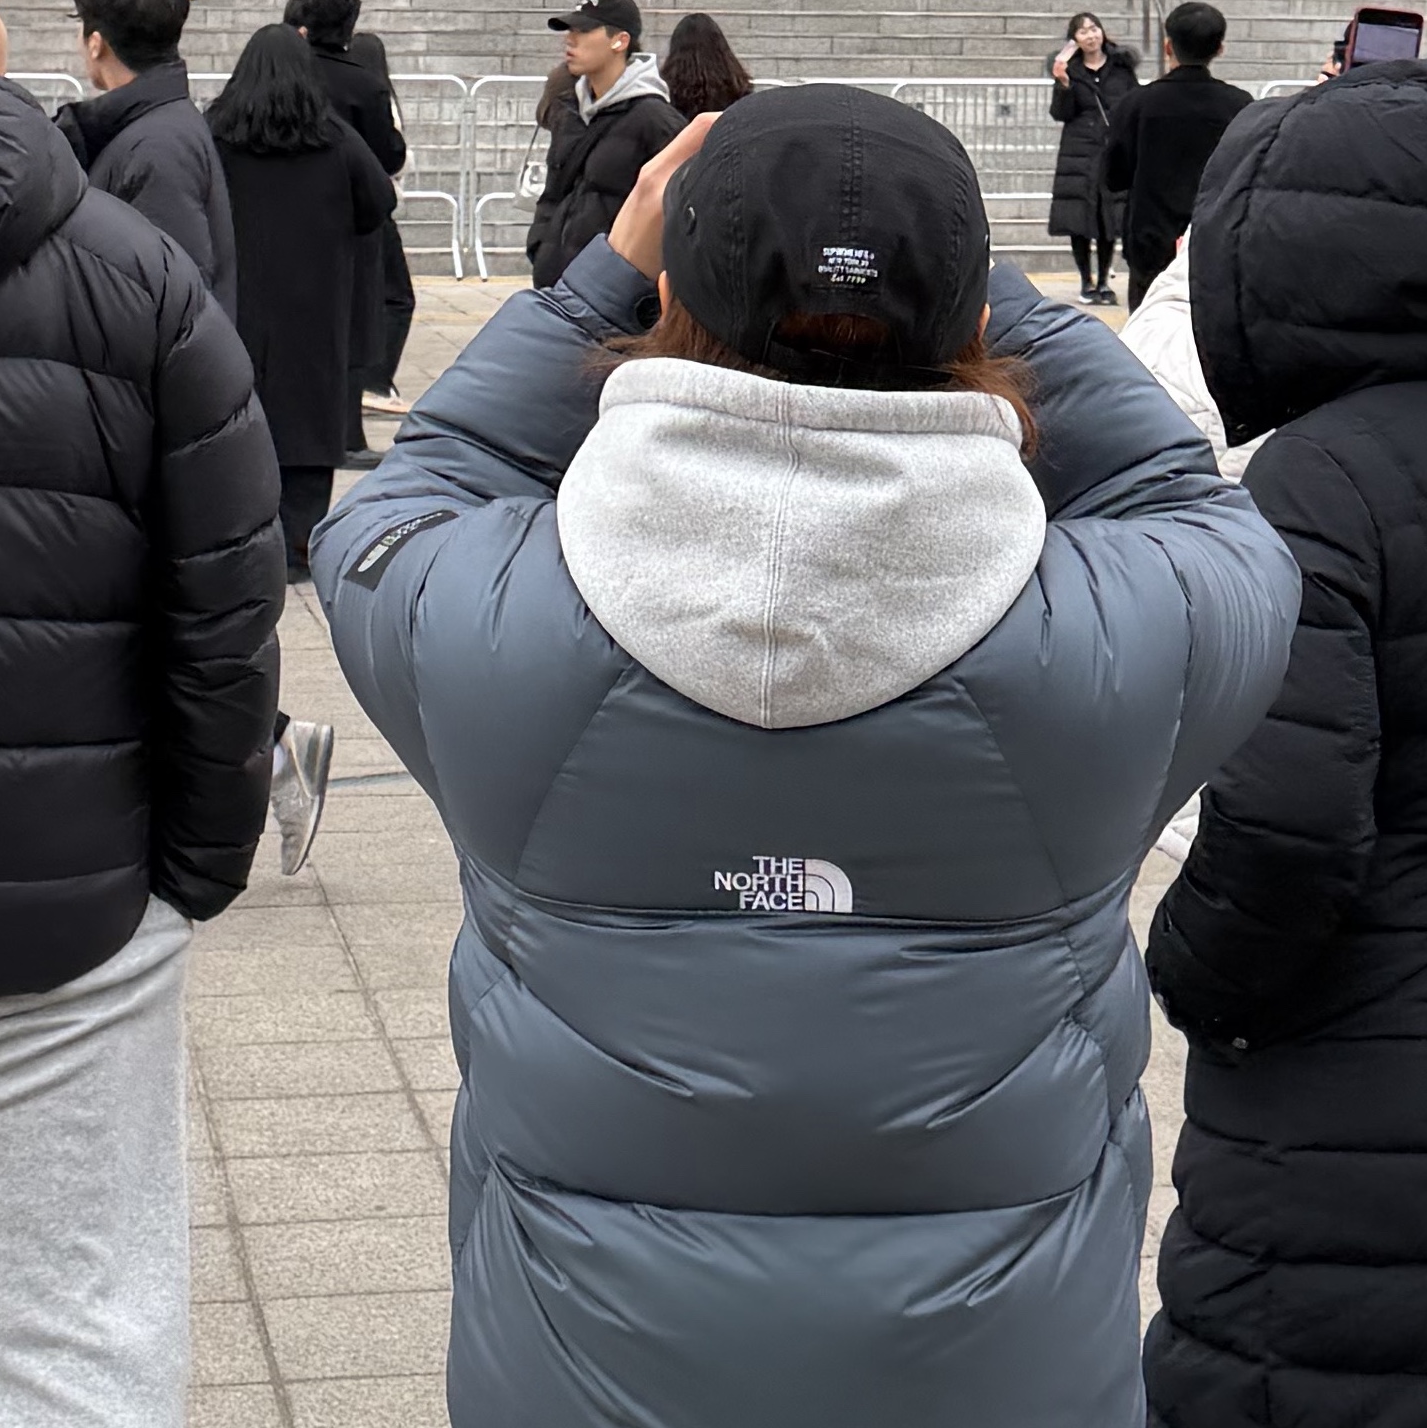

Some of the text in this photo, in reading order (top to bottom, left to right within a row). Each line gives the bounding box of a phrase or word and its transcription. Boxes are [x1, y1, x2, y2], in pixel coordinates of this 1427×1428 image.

[752, 855, 804, 875] THE
[714, 870, 804, 892] NORTH
[739, 890, 804, 911] FACE
